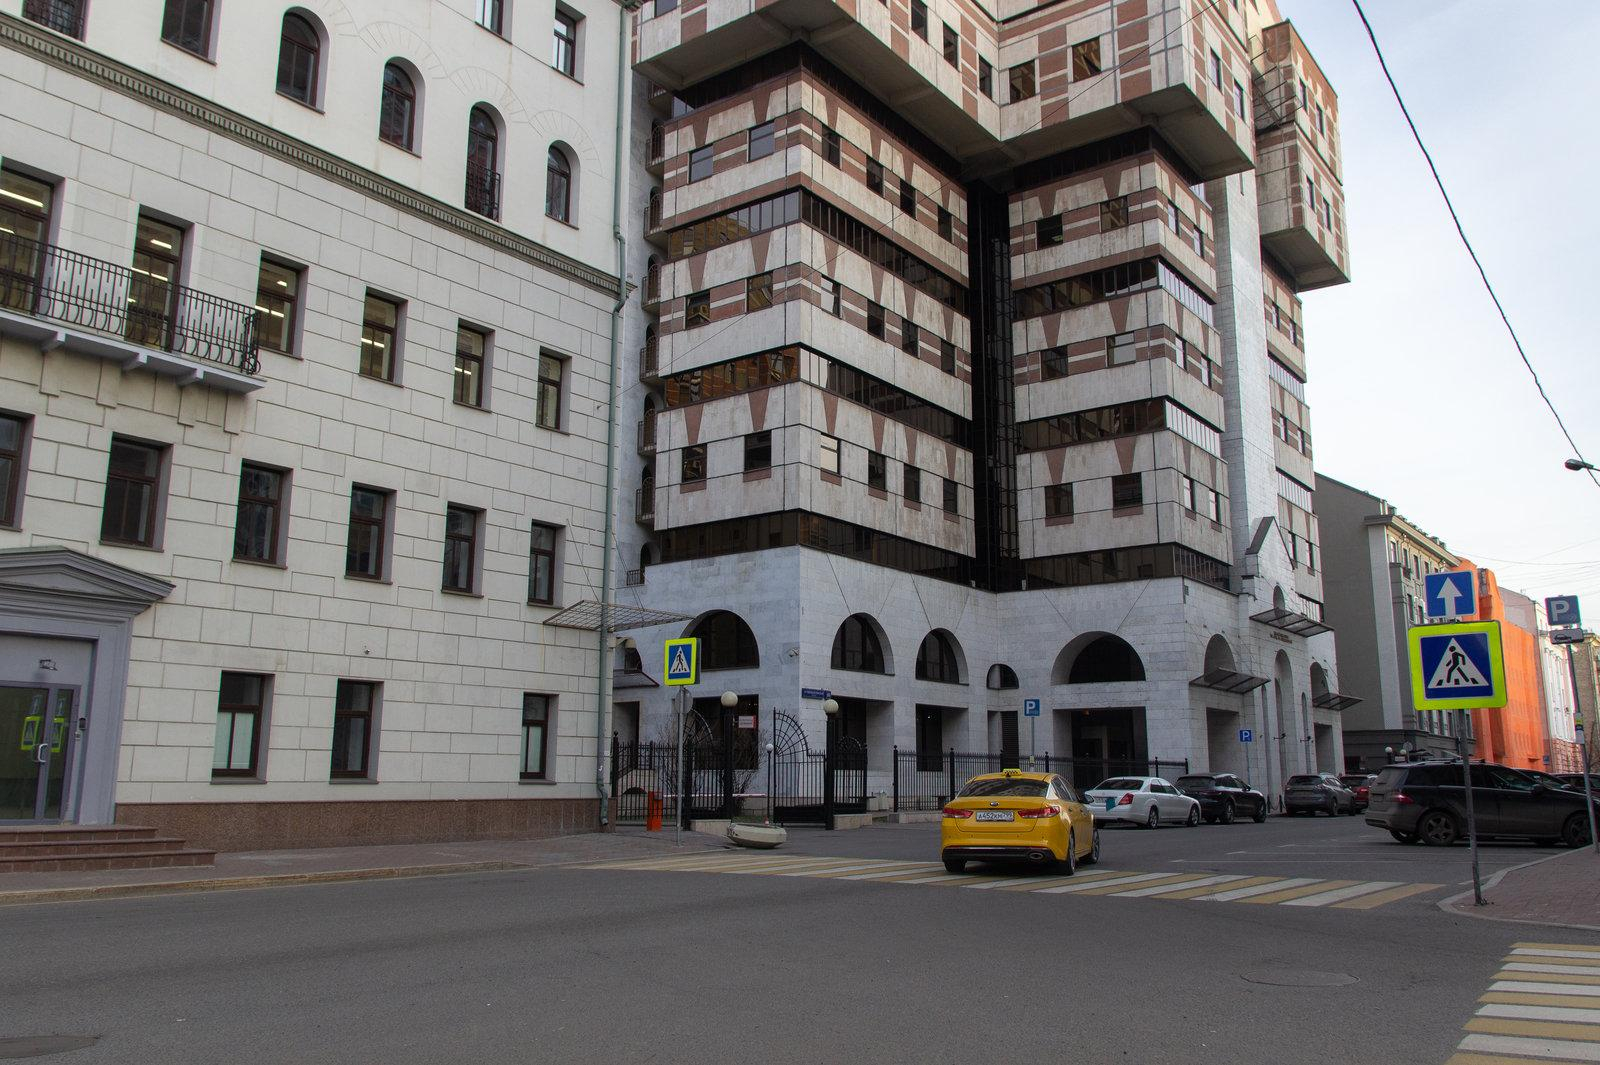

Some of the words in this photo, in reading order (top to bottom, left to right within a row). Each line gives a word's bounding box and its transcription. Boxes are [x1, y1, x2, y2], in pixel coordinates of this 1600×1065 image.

[1551, 600, 1570, 622] P
[1026, 701, 1036, 714] P
[1242, 730, 1250, 741] P
